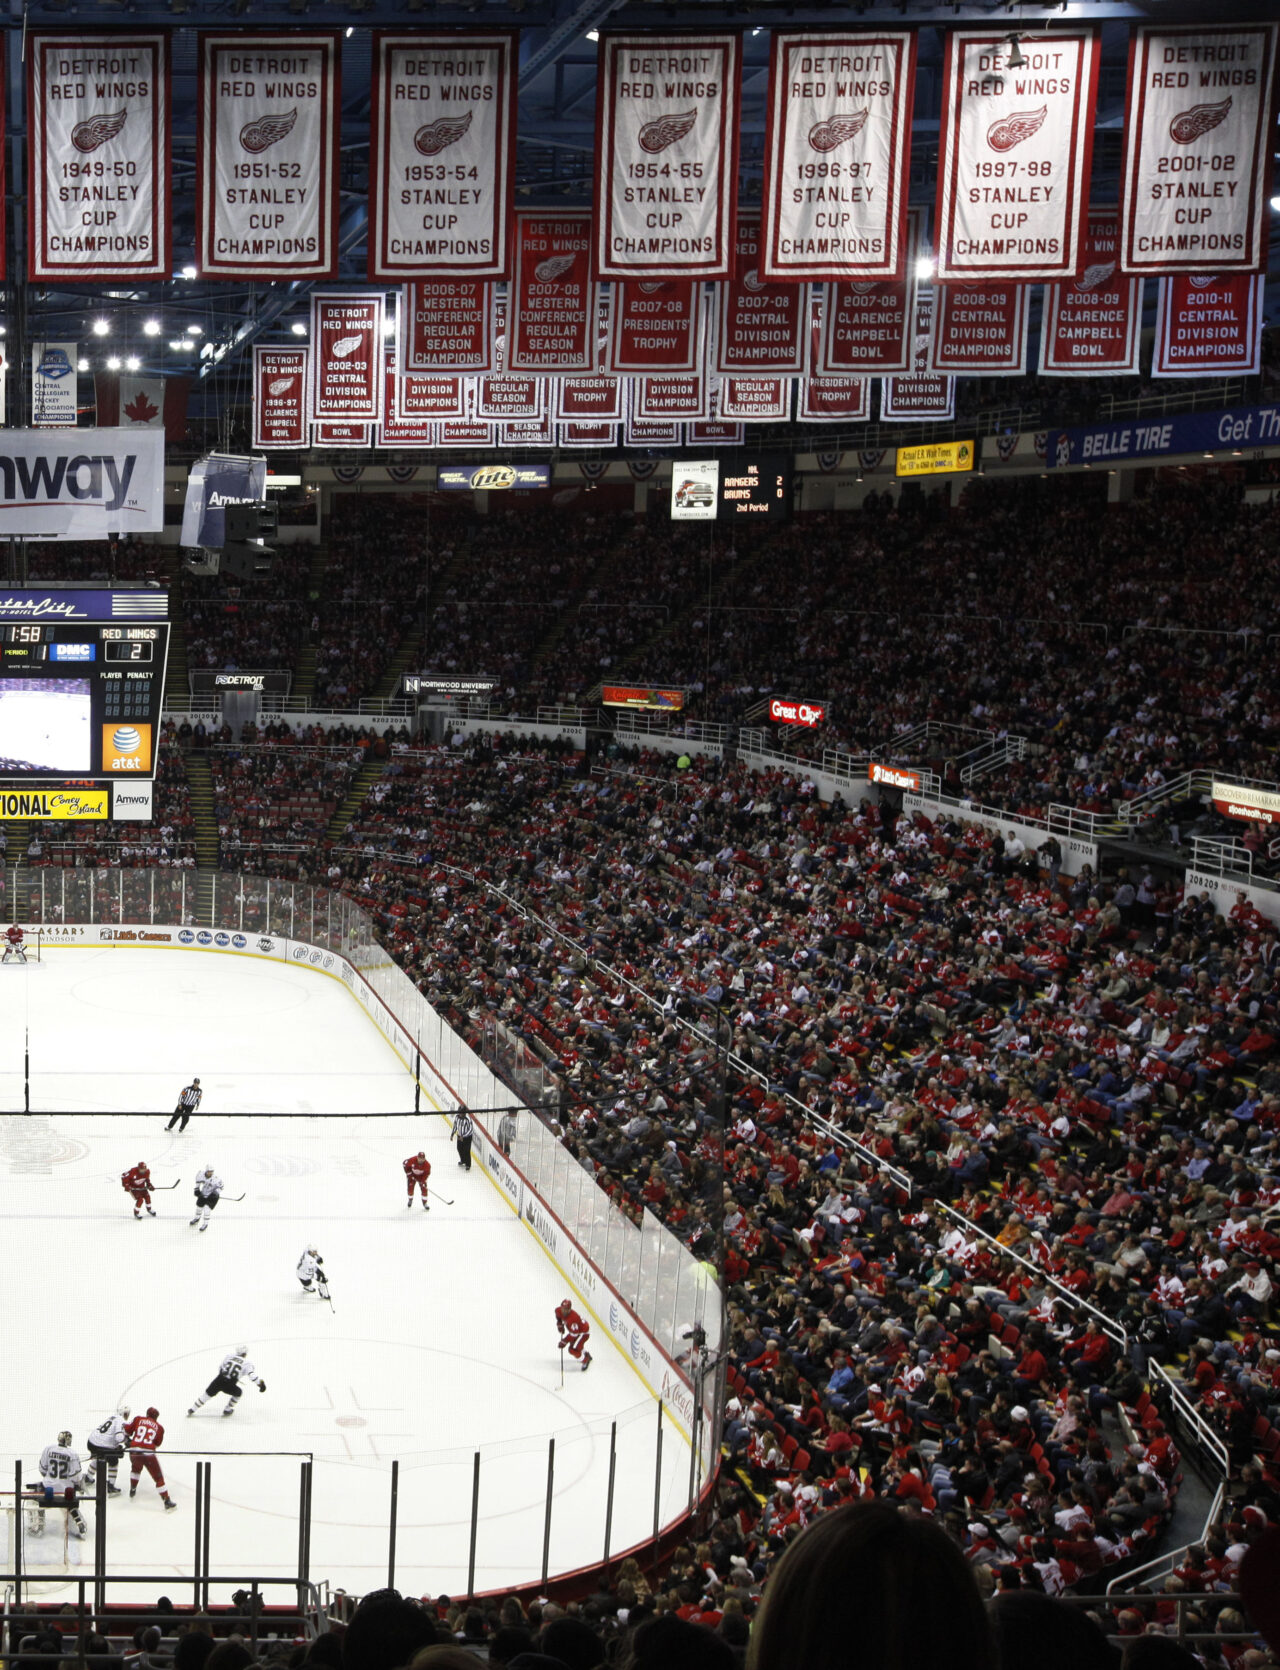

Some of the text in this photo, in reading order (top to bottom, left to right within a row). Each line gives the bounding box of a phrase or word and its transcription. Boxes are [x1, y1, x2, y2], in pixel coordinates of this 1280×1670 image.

[1163, 45, 1248, 64] DETROIT
[60, 58, 138, 76] DETROIT
[630, 57, 709, 74] DETROIT
[1151, 69, 1257, 88] RED WINGS
[51, 82, 148, 100] RED WINGS
[621, 82, 717, 99] RED WINGS
[62, 162, 136, 178] 1949-50
[629, 163, 703, 179] 1954-55
[1158, 156, 1235, 173] 2001-02
[59, 186, 139, 202] STANLEY
[624, 186, 705, 203] STANLEY
[1152, 181, 1237, 199] STANLEY
[82, 212, 116, 227] CUP
[647, 212, 682, 228] CUP
[1175, 209, 1212, 225] CUP
[50, 236, 149, 252] CHAMPIONS
[613, 237, 713, 253] CHAMPIONS
[1138, 234, 1243, 252] CHAMPIONS
[1187, 293, 1232, 304] 2010-11
[328, 309, 368, 317] DETROIT
[631, 302, 682, 312] 2007-08
[1179, 311, 1237, 322] CENTRAL
[323, 321, 373, 329] RED WINGS
[1178, 328, 1238, 339] DIVISION
[633, 338, 677, 348] TROPHY
[1170, 344, 1244, 357] CHAMPIONS
[328, 362, 366, 370] 2002-03
[321, 400, 371, 408] CHAMPIONS
[1219, 413, 1252, 442] Get
[1083, 425, 1173, 457] BELLE TIRE
[725, 476, 782, 486] RANGERS 2
[724, 490, 750, 499] BRUINS
[11, 627, 40, 641] 1:58
[103, 629, 156, 639] RED WINGS
[42, 646, 46, 659] 1
[57, 645, 89, 654] DMC
[131, 645, 141, 658] 2
[772, 702, 796, 719] Great
[112, 757, 140, 769] at&t
[51, 795, 80, 807] Coney
[67, 798, 102, 814] Island
[116, 794, 149, 805] Amway
[1189, 875, 1218, 889] 208 209
[114, 931, 137, 941] Little
[135, 1426, 157, 1444] 93
[49, 1460, 69, 1478] 32
